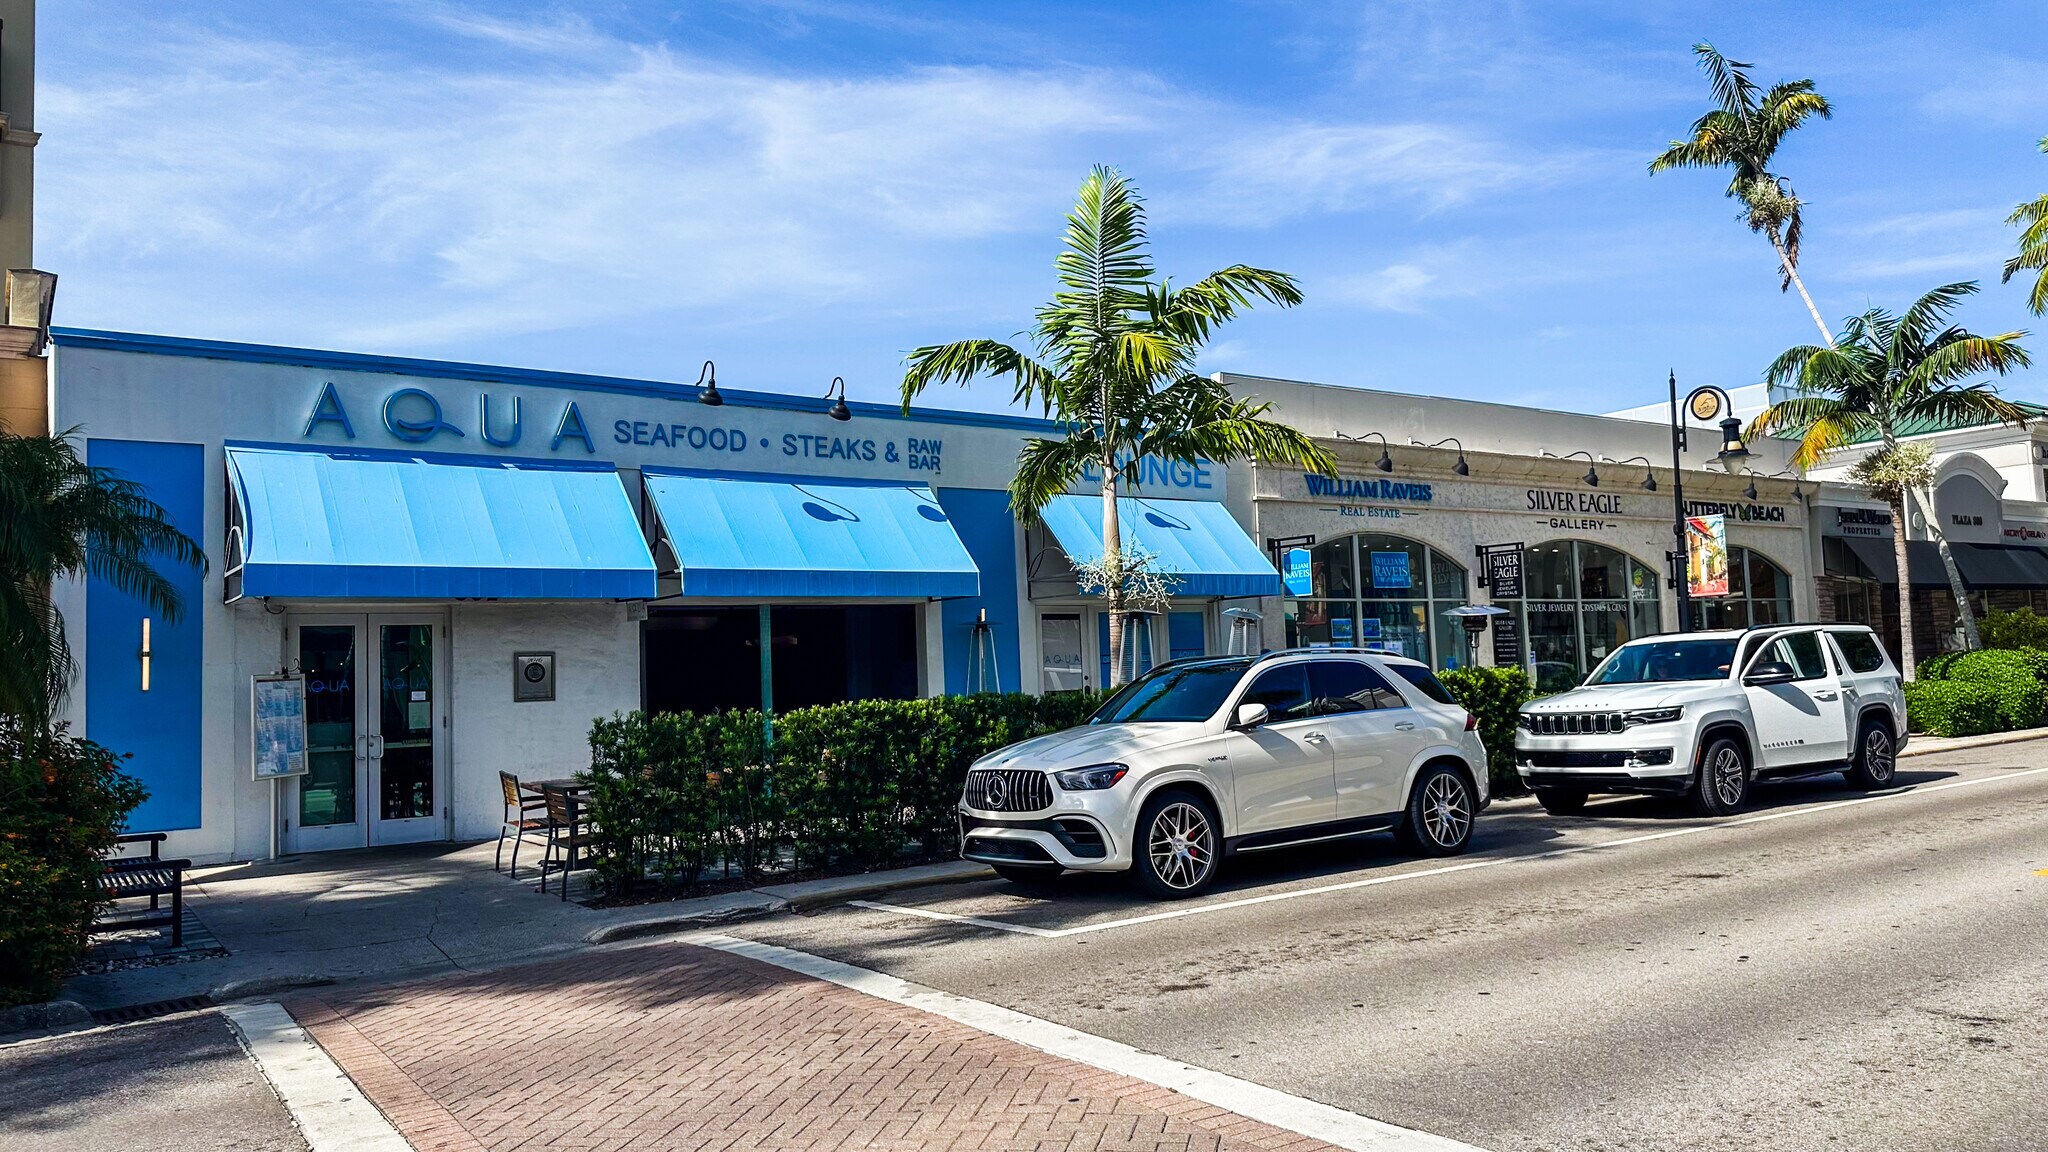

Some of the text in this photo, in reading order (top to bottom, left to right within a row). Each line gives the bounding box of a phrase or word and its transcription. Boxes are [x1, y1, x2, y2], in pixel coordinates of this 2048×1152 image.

[303, 382, 596, 454] AQUA
[614, 419, 900, 463] SEAFOOD STEAKS &
[908, 437, 942, 455] RAW
[909, 454, 941, 471] BAR
[1304, 474, 1433, 501] WILLIAM RAVEIS
[1527, 489, 1623, 514] SILVER EAGLE
[1340, 505, 1401, 518] REAL ESTATE
[1682, 500, 1785, 522] UTTERFLY BEACH
[1550, 518, 1605, 530] GALLERY
[1952, 514, 1972, 526] PLAZA
[1843, 526, 1881, 536] PROPERTIES
[1375, 557, 1406, 566] WILLIAM
[1492, 554, 1519, 567] SILVER
[1375, 566, 1408, 577] RAVEIS
[1494, 566, 1519, 579] EAGLE
[1526, 603, 1547, 612] SILVER
[1548, 603, 1575, 612] JEWELRY
[1045, 654, 1080, 664] AQUA
